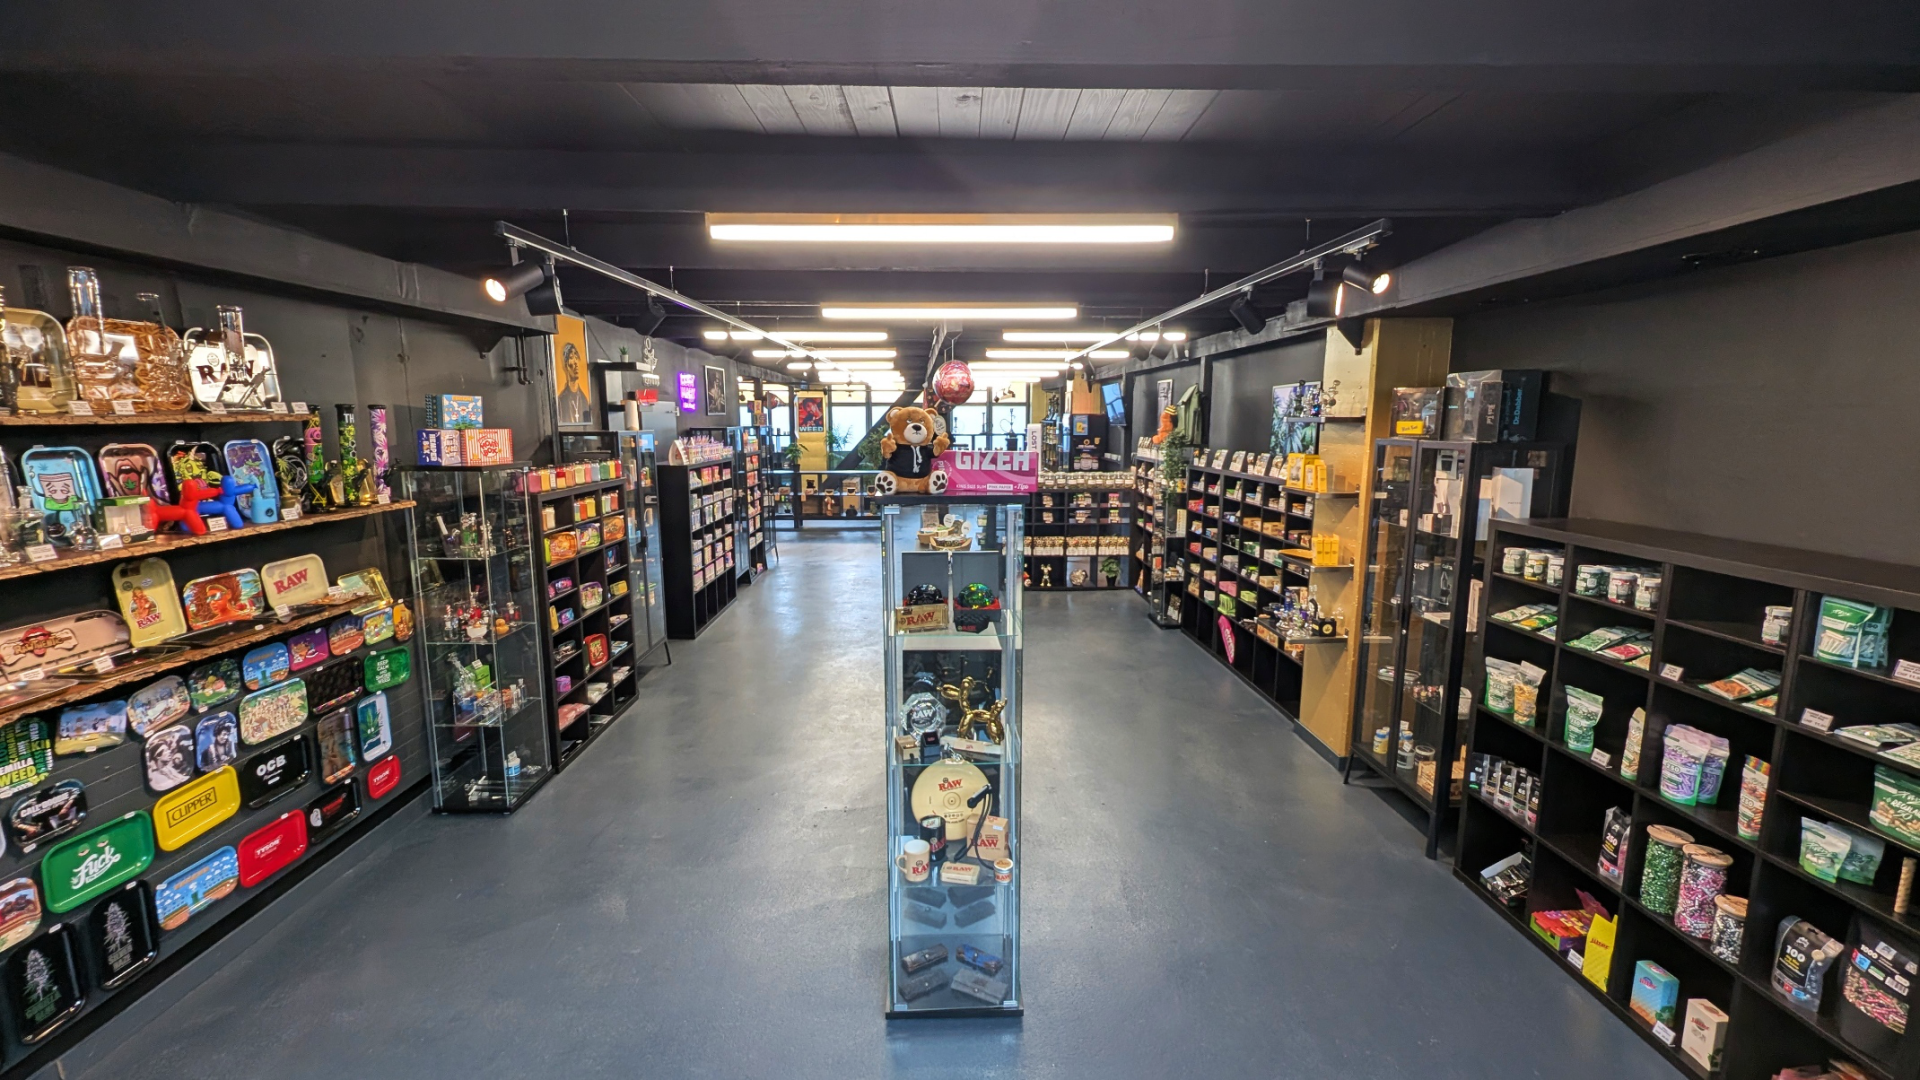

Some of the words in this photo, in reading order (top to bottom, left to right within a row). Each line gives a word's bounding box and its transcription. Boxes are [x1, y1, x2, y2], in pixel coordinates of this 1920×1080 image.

[955, 451, 1030, 472] GIZEH
[273, 568, 308, 594] RAW
[136, 612, 162, 629] RAW
[906, 611, 936, 626] RAW
[911, 708, 935, 720] RAW
[256, 754, 287, 777] OCB
[0, 765, 37, 788] WEED
[938, 778, 963, 791] RAW
[171, 792, 213, 821] CLIPPER
[256, 838, 281, 856] TYSON
[1605, 832, 1618, 847] 250
[71, 845, 121, 890] Fuck
[995, 873, 1012, 881] RAW
[1785, 944, 1806, 964] 100
[1860, 943, 1879, 960] 1000
